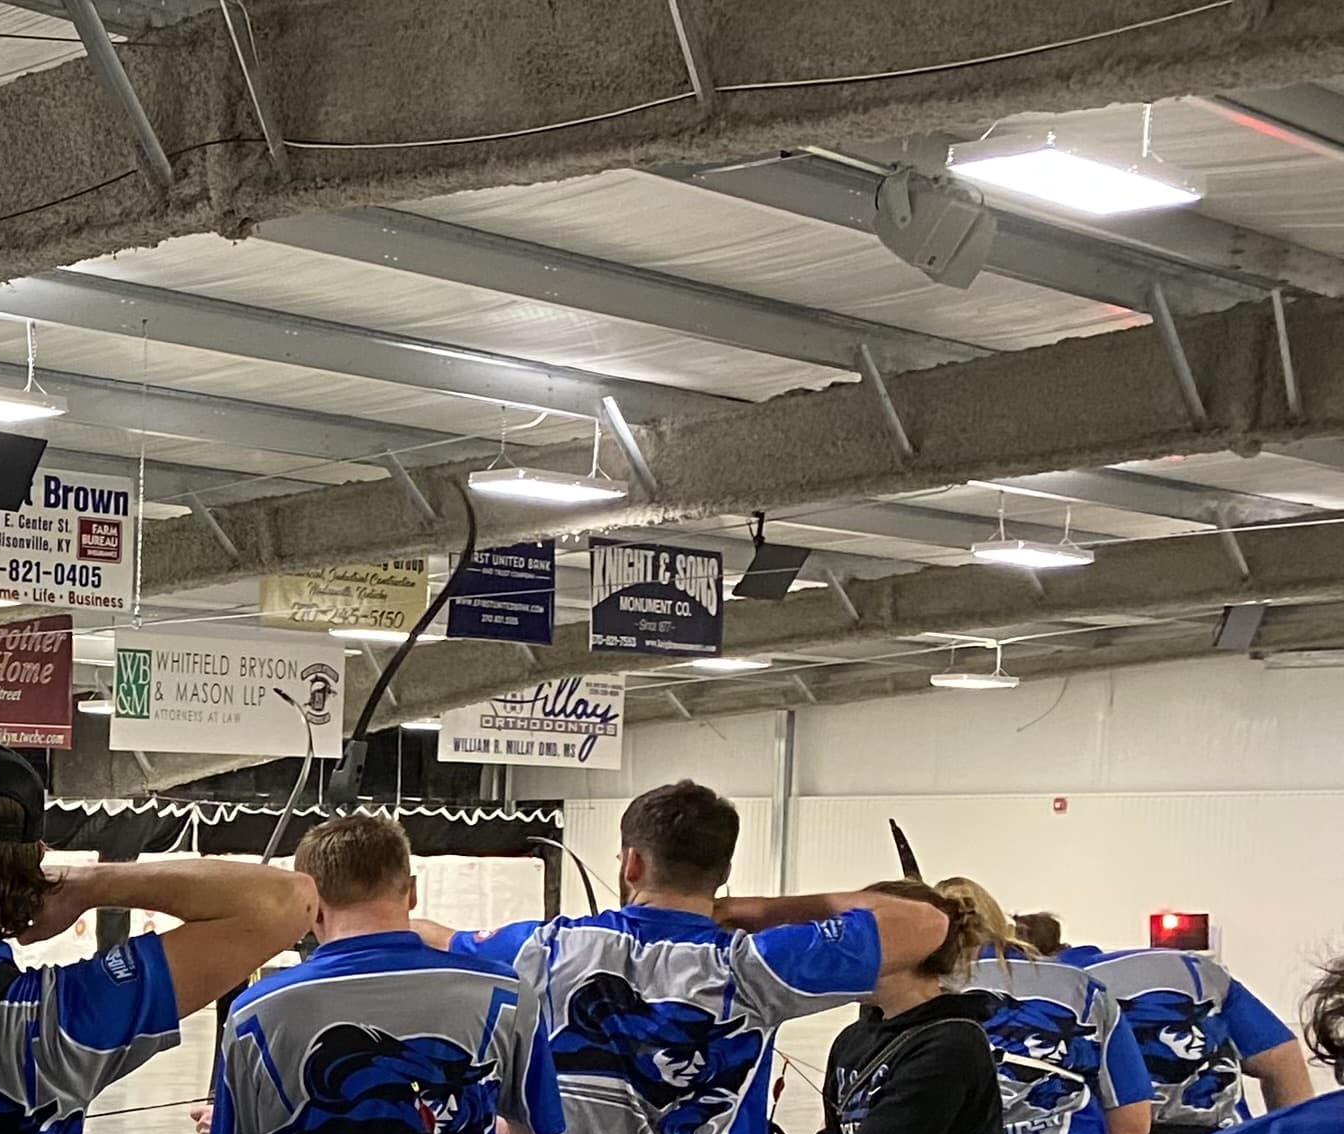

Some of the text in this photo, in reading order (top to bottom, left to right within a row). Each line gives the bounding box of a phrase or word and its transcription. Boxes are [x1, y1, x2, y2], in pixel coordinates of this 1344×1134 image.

[43, 474, 130, 518] Brown
[4, 513, 15, 528] E.
[18, 515, 53, 533] Center
[57, 517, 72, 534] St.
[92, 522, 119, 537] FARM
[57, 538, 72, 554] KY
[81, 533, 119, 548] BUREAU
[492, 553, 526, 569] UNITED
[527, 557, 552, 572] BANK
[592, 545, 719, 617] KNIGHT & SONS
[32, 587, 56, 604] Life
[67, 590, 124, 610] Business
[619, 595, 693, 617] MONUMENT CO.
[154, 650, 230, 677] WHITFIELD
[239, 656, 299, 680] BRYSON
[154, 683, 266, 707] & MASON LLP
[154, 709, 242, 725] ATTORNEYS AT LAW
[481, 716, 617, 736] ORTHODONTICS
[452, 736, 491, 753] WILLIAM
